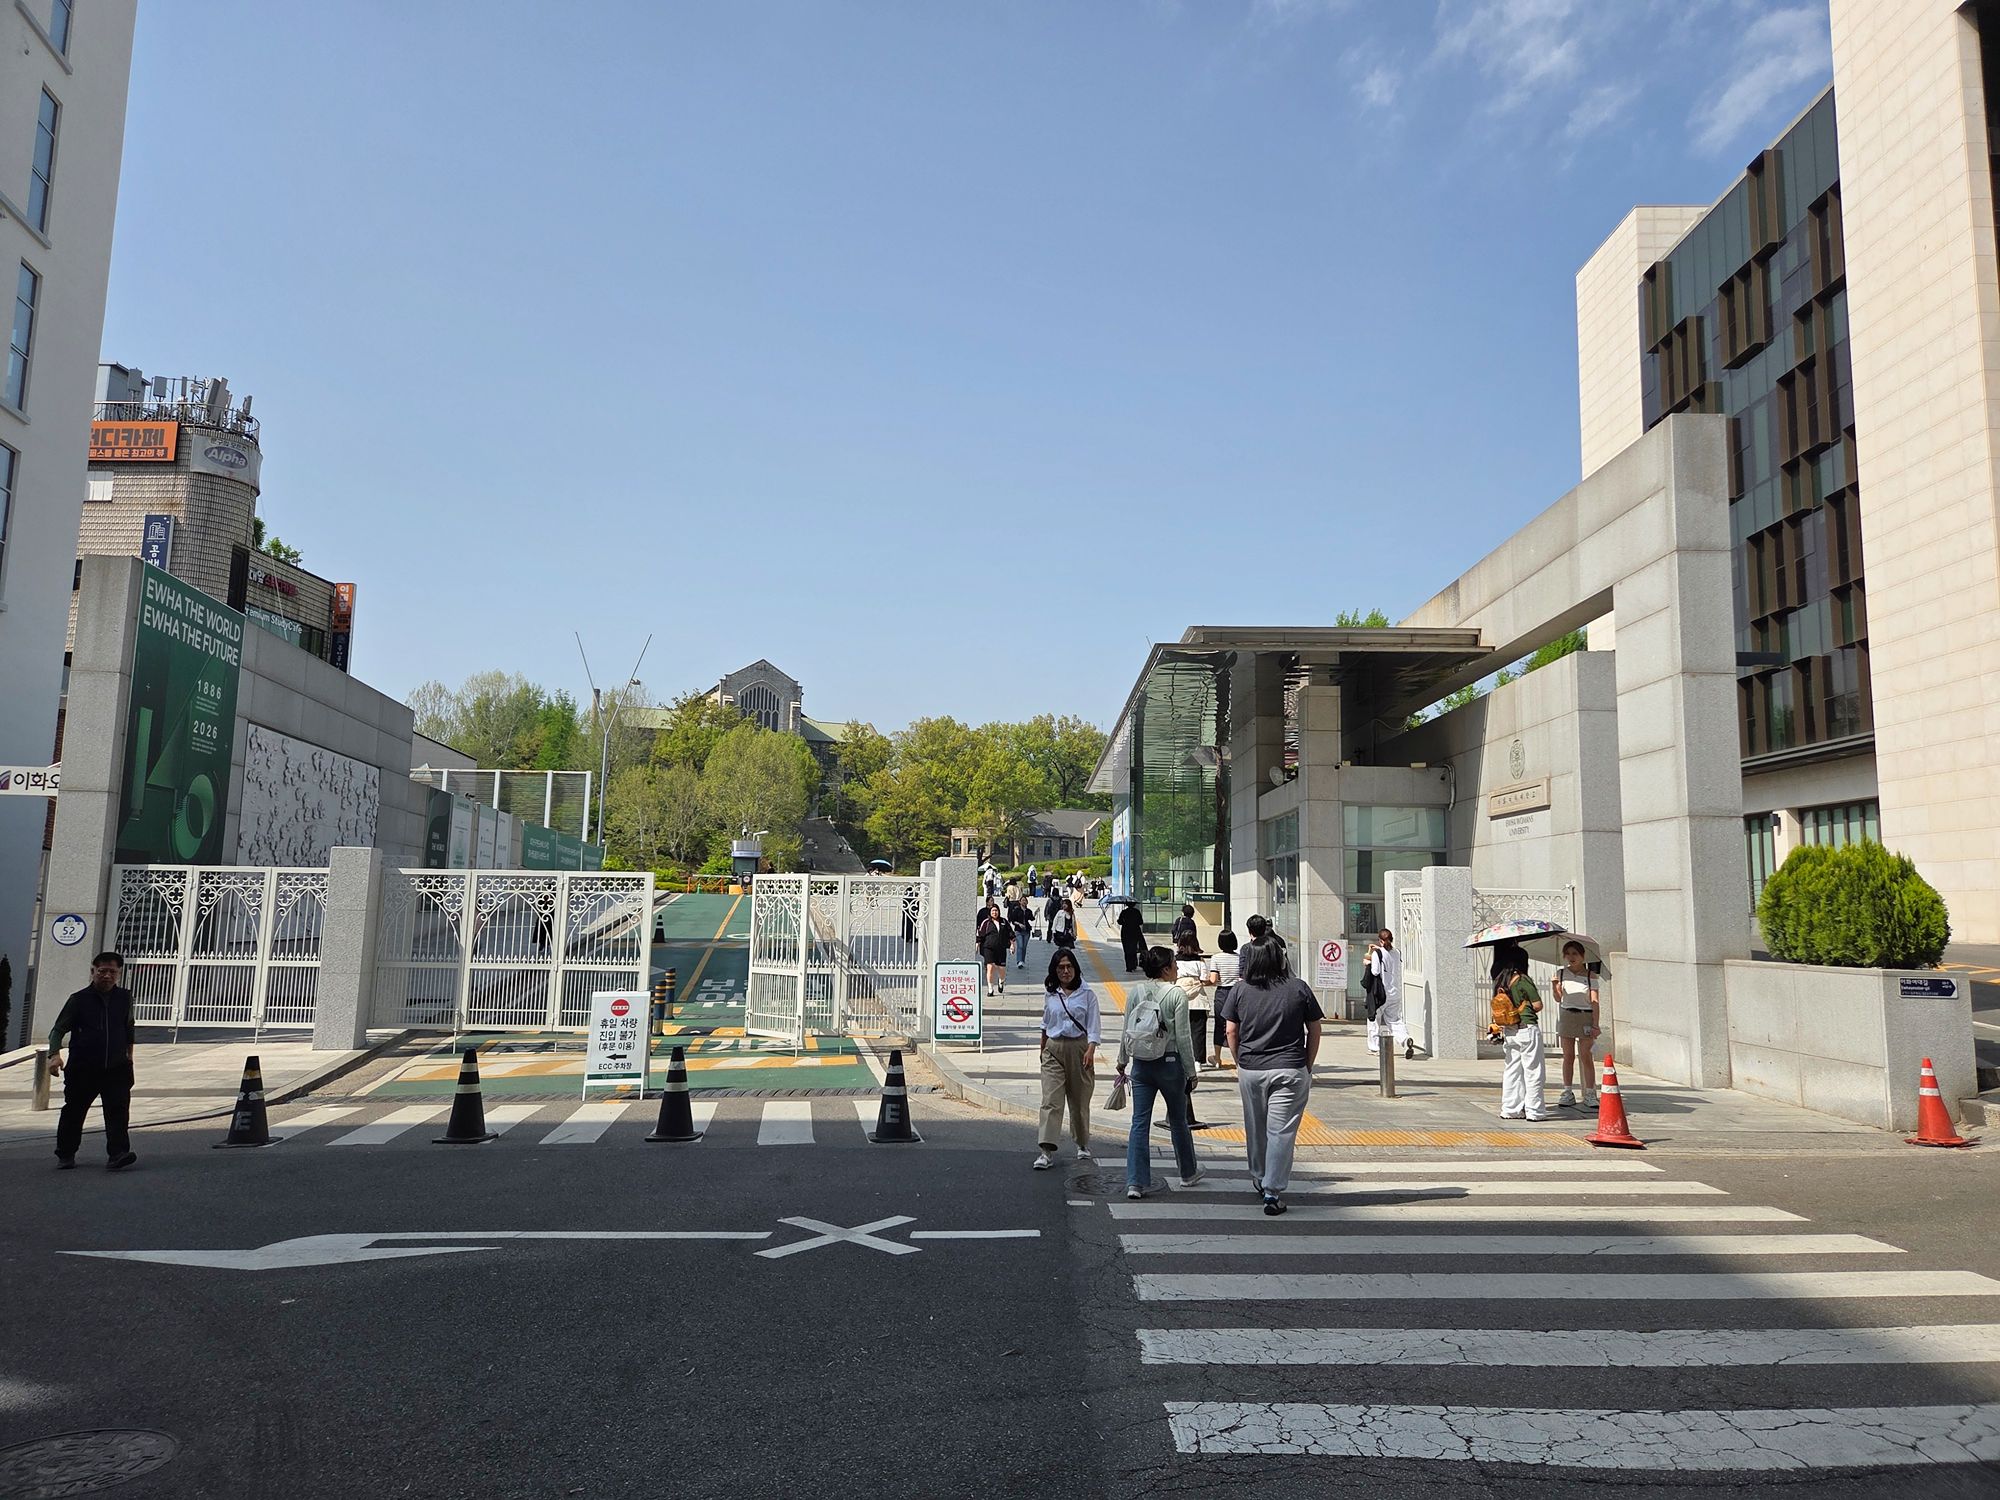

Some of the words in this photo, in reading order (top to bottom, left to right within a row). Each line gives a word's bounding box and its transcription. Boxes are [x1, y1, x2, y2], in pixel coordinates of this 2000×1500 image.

[207, 448, 246, 467] Alpha
[146, 577, 182, 614] EWHA
[184, 596, 206, 625] THE
[206, 608, 241, 642] WORLD
[143, 604, 180, 640] EWHA
[182, 622, 201, 650] THE
[202, 633, 239, 667] FUTURE
[198, 680, 222, 699] 1886
[193, 720, 218, 739] 2026
[62, 926, 76, 936] 52
[940, 983, 976, 995] 진입금지
[600, 1018, 618, 1029] 휴일
[620, 1018, 638, 1029] 차량
[599, 1030, 616, 1041] 진입
[619, 1030, 637, 1041] 불가
[598, 1042, 616, 1051] (후문
[618, 1042, 636, 1051] 이용)
[614, 1062, 632, 1070] 주차장
[234, 1111, 253, 1131] E
[884, 1103, 901, 1124] E
